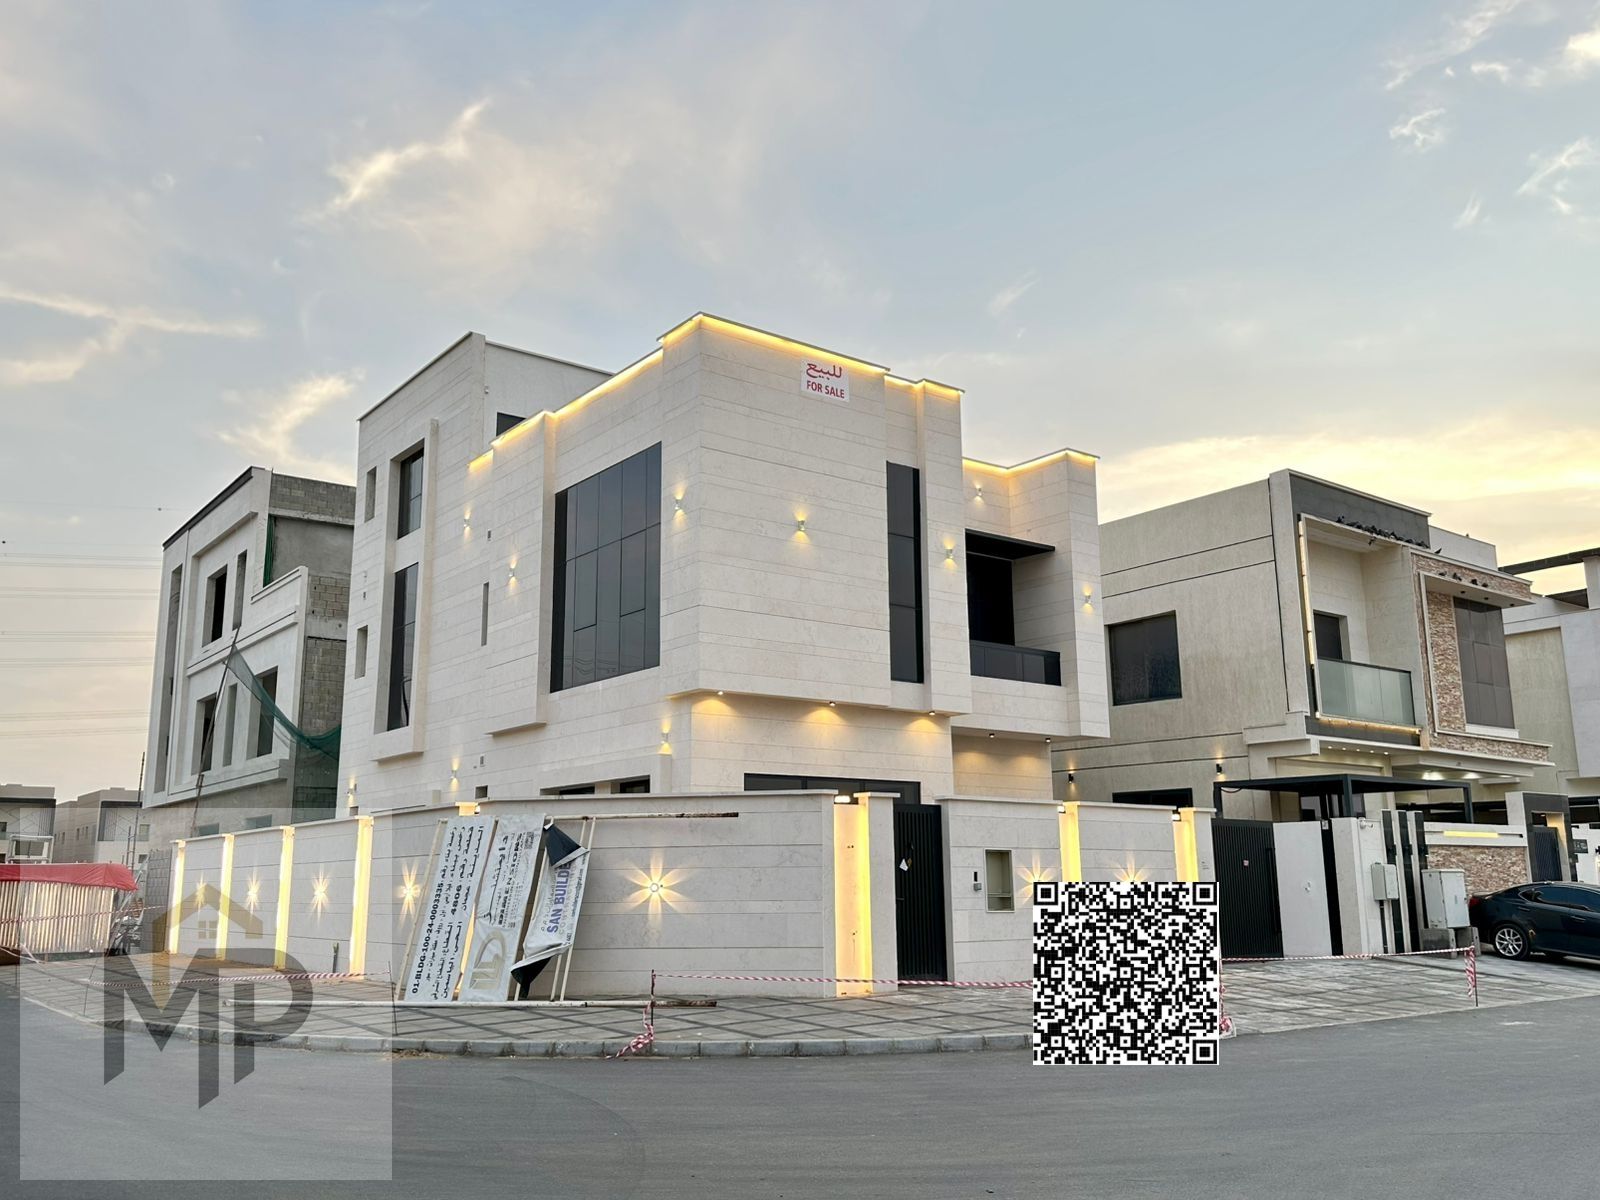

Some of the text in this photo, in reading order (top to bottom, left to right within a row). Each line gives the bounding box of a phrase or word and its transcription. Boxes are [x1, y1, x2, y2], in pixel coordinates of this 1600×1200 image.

[806, 363, 842, 380] للبيع
[806, 380, 845, 399] FOR SALE
[498, 832, 522, 925] DIMENSIONS
[553, 862, 571, 905] BUILDE
[546, 909, 562, 933] SAN
